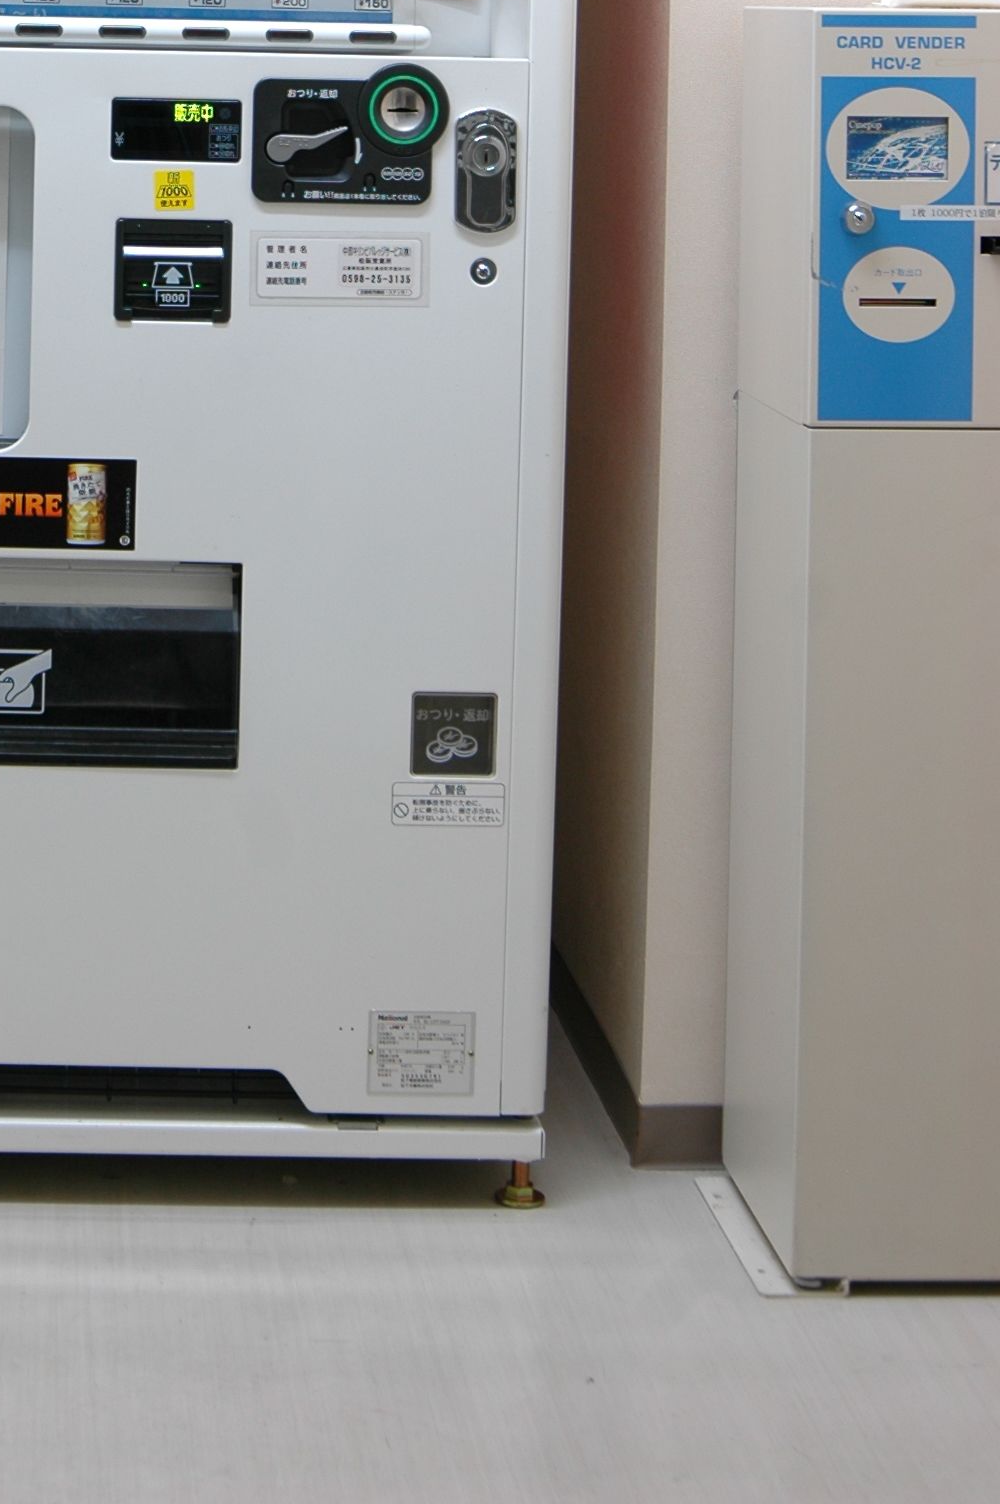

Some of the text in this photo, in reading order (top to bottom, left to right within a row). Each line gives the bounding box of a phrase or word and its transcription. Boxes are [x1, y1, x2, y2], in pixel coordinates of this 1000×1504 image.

[836, 35, 966, 50] CARD VENDER
[871, 57, 922, 70] HCV-2
[287, 88, 338, 100] おつり・返却
[173, 103, 214, 122] 販売中
[160, 186, 189, 197] 1000
[342, 273, 412, 285] 0598-25-3135
[160, 292, 186, 304] 1000
[415, 707, 490, 723] おつり・返却
[445, 784, 468, 797] 警告
